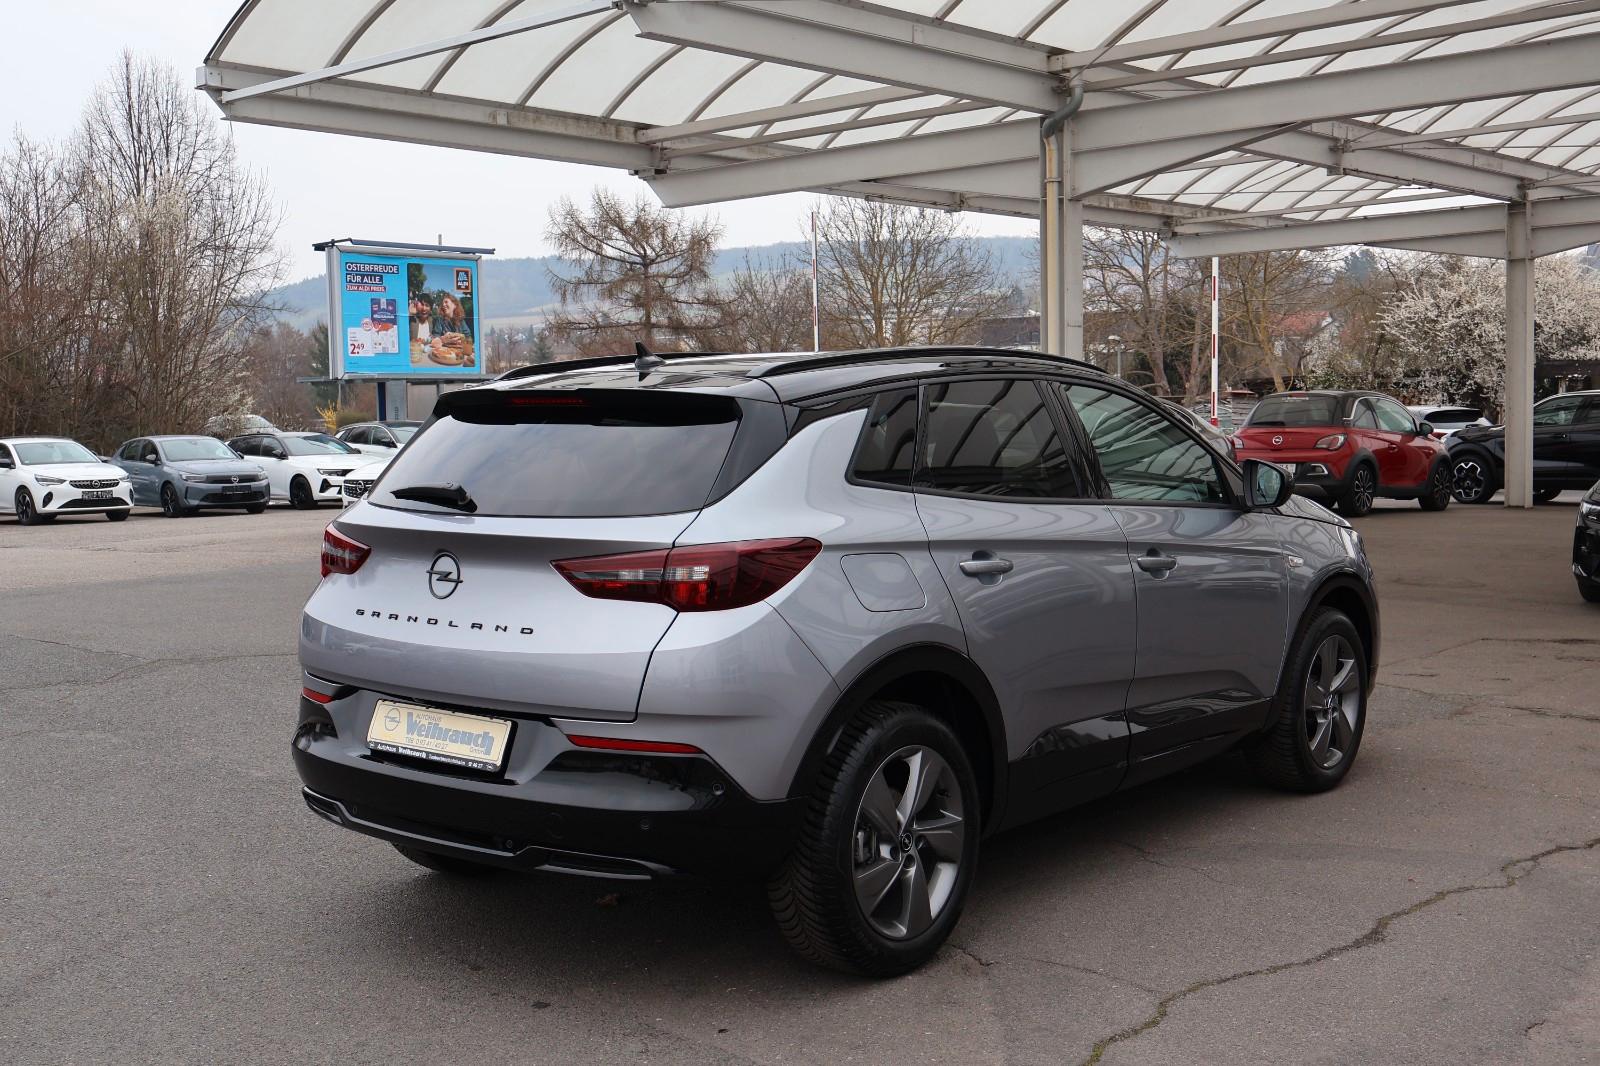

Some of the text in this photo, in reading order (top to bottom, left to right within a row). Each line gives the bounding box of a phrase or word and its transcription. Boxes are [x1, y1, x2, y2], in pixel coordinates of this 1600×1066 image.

[346, 263, 399, 273] OSTERFREUDE
[346, 274, 362, 283] FÜR
[355, 608, 534, 635] GRANDLAND
[406, 711, 495, 755] Weihrauch
